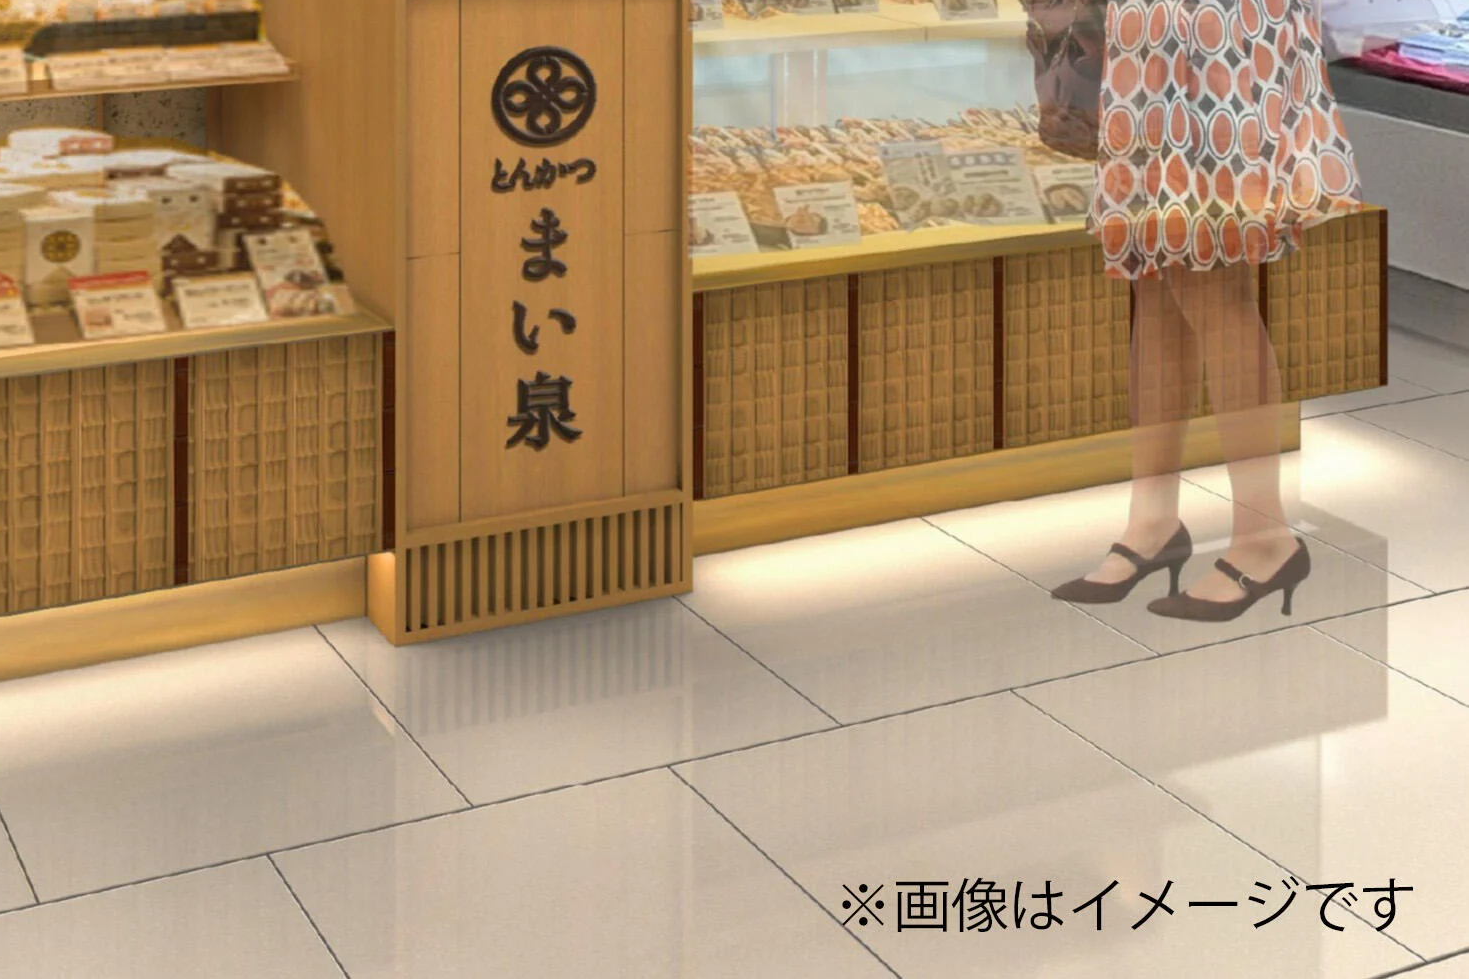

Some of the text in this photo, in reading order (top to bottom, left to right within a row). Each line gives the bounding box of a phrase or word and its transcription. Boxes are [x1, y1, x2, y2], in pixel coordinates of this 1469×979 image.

[491, 157, 597, 194] とんかつ
[505, 207, 583, 451] まい泉
